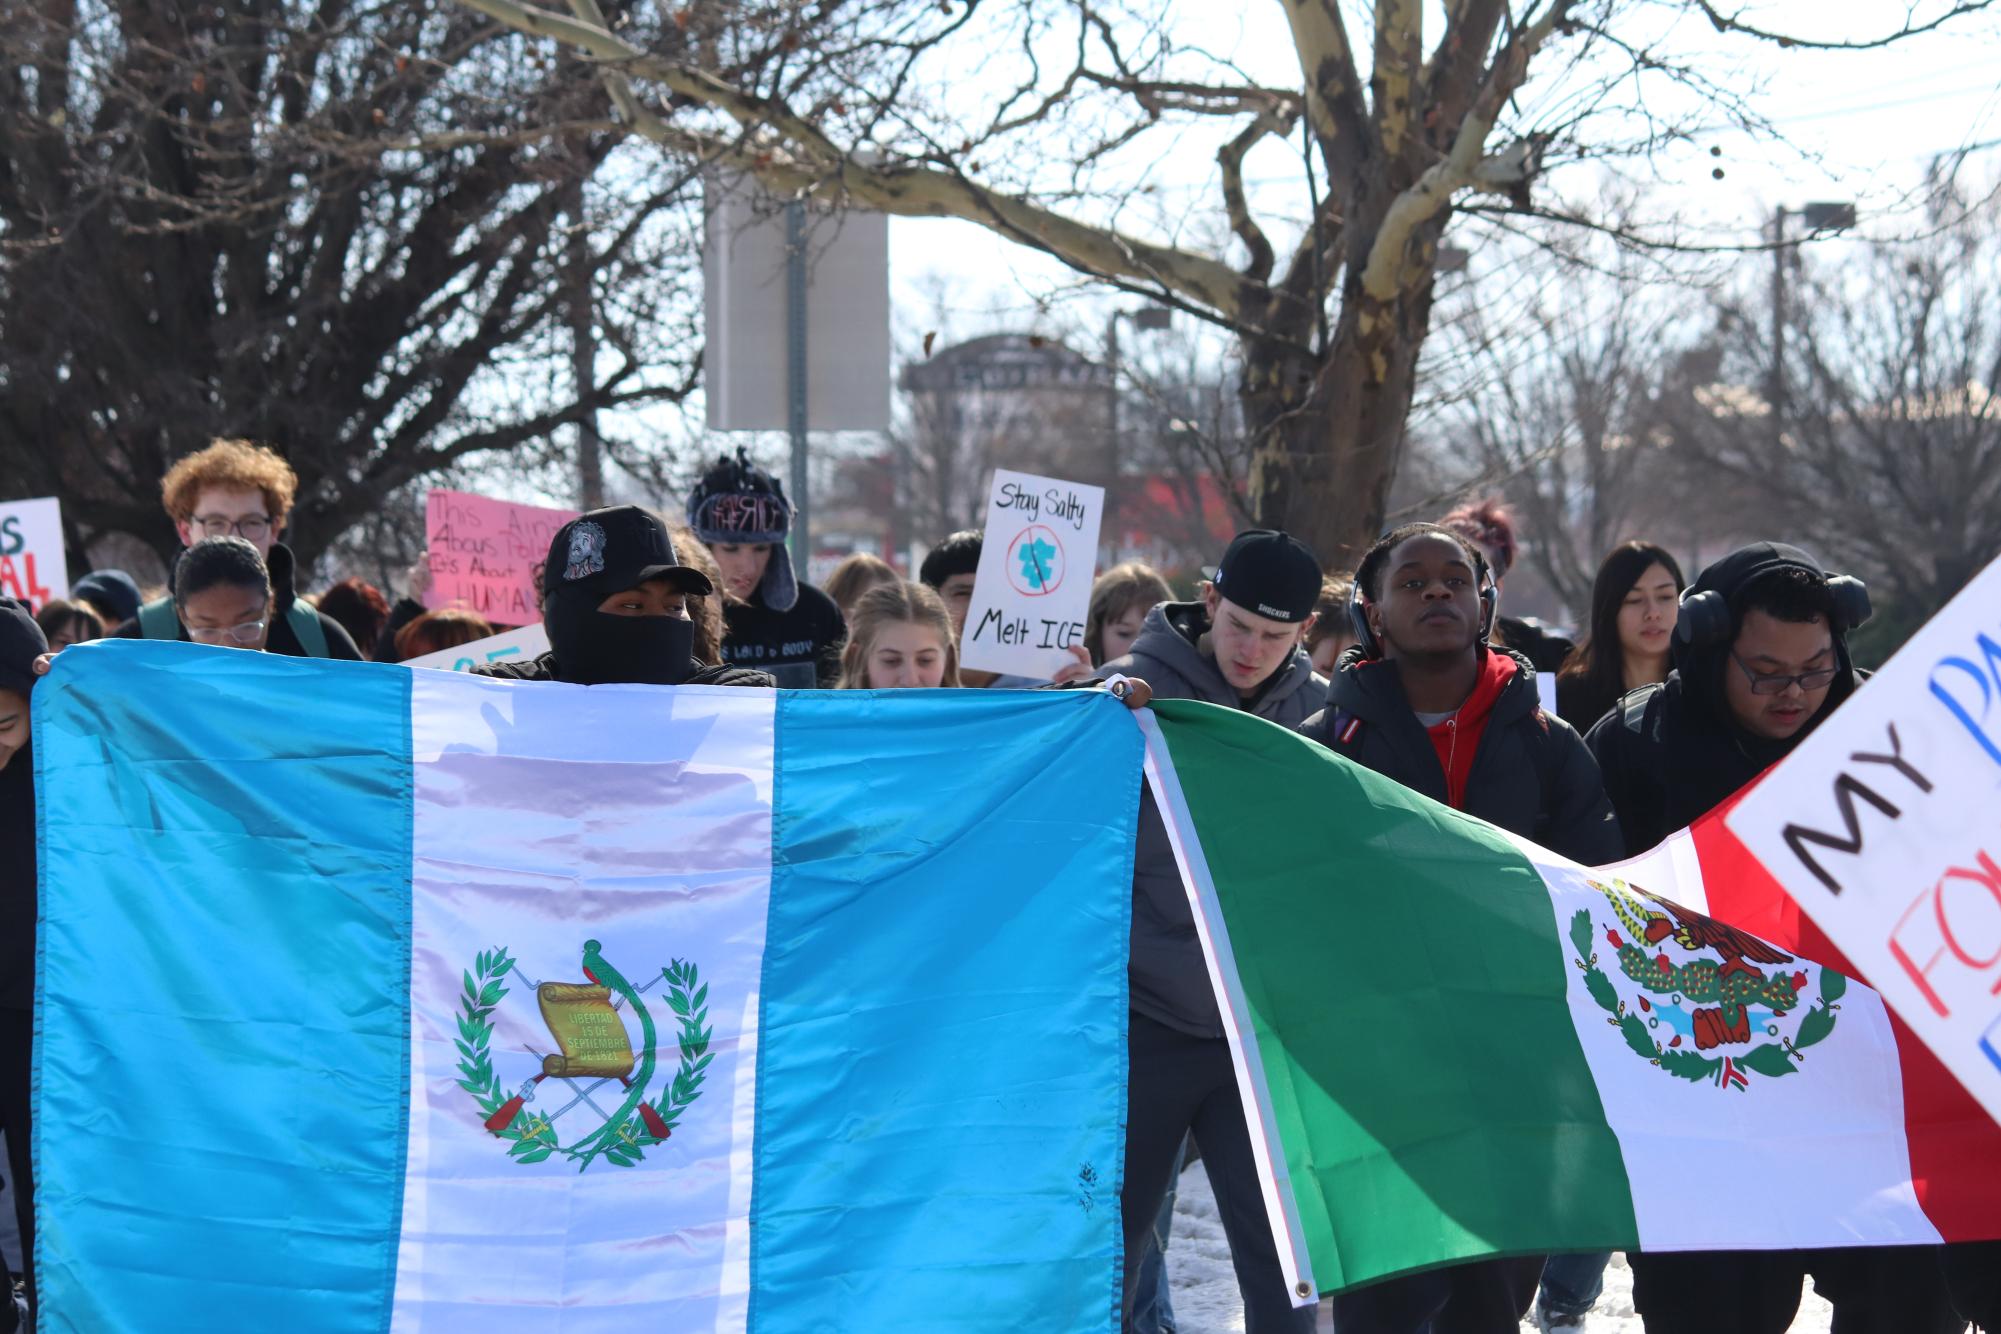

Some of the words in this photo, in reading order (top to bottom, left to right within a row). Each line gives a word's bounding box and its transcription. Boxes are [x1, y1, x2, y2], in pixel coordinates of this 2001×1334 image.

[429, 493, 482, 528] This
[996, 483, 1039, 522] Stay
[1045, 489, 1085, 530] Salty
[470, 556, 516, 577] About
[973, 608, 1029, 645] Melt
[1036, 619, 1085, 650] ICE
[1782, 721, 1933, 897] MY
[568, 1012, 614, 1024] LIBERTAD
[582, 1026, 593, 1037] 15
[595, 1026, 608, 1037] DE
[567, 1037, 626, 1049] SEPTIEMBRE
